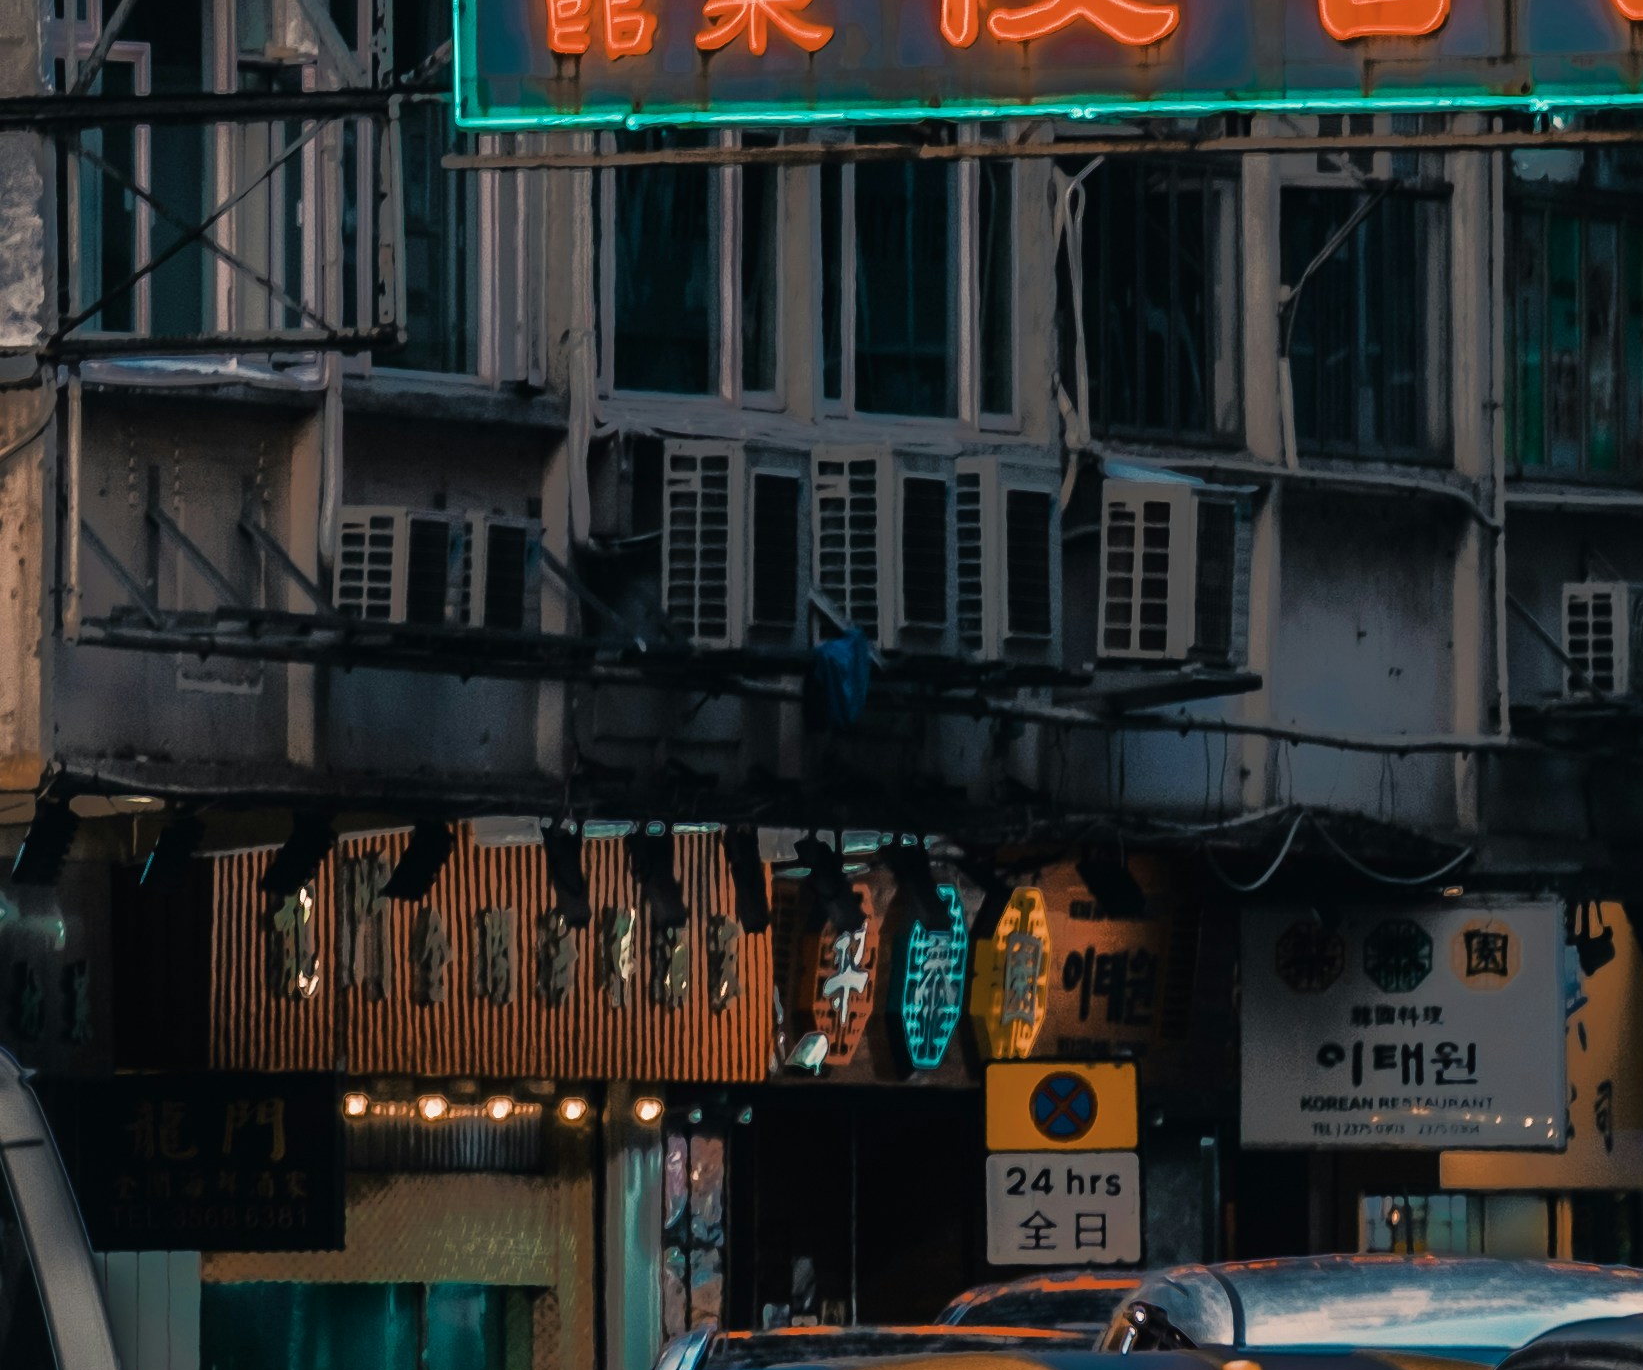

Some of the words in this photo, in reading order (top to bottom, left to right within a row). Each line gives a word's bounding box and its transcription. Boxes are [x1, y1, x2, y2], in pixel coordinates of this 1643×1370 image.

[1317, 1039, 1478, 1088] 이태원
[1300, 1095, 1374, 1112] KOREAN
[1378, 1095, 1493, 1111] RESTAURANT
[1006, 1166, 1054, 1196] 24
[1066, 1167, 1122, 1197] hrs
[1018, 1210, 1107, 1250] 全日
